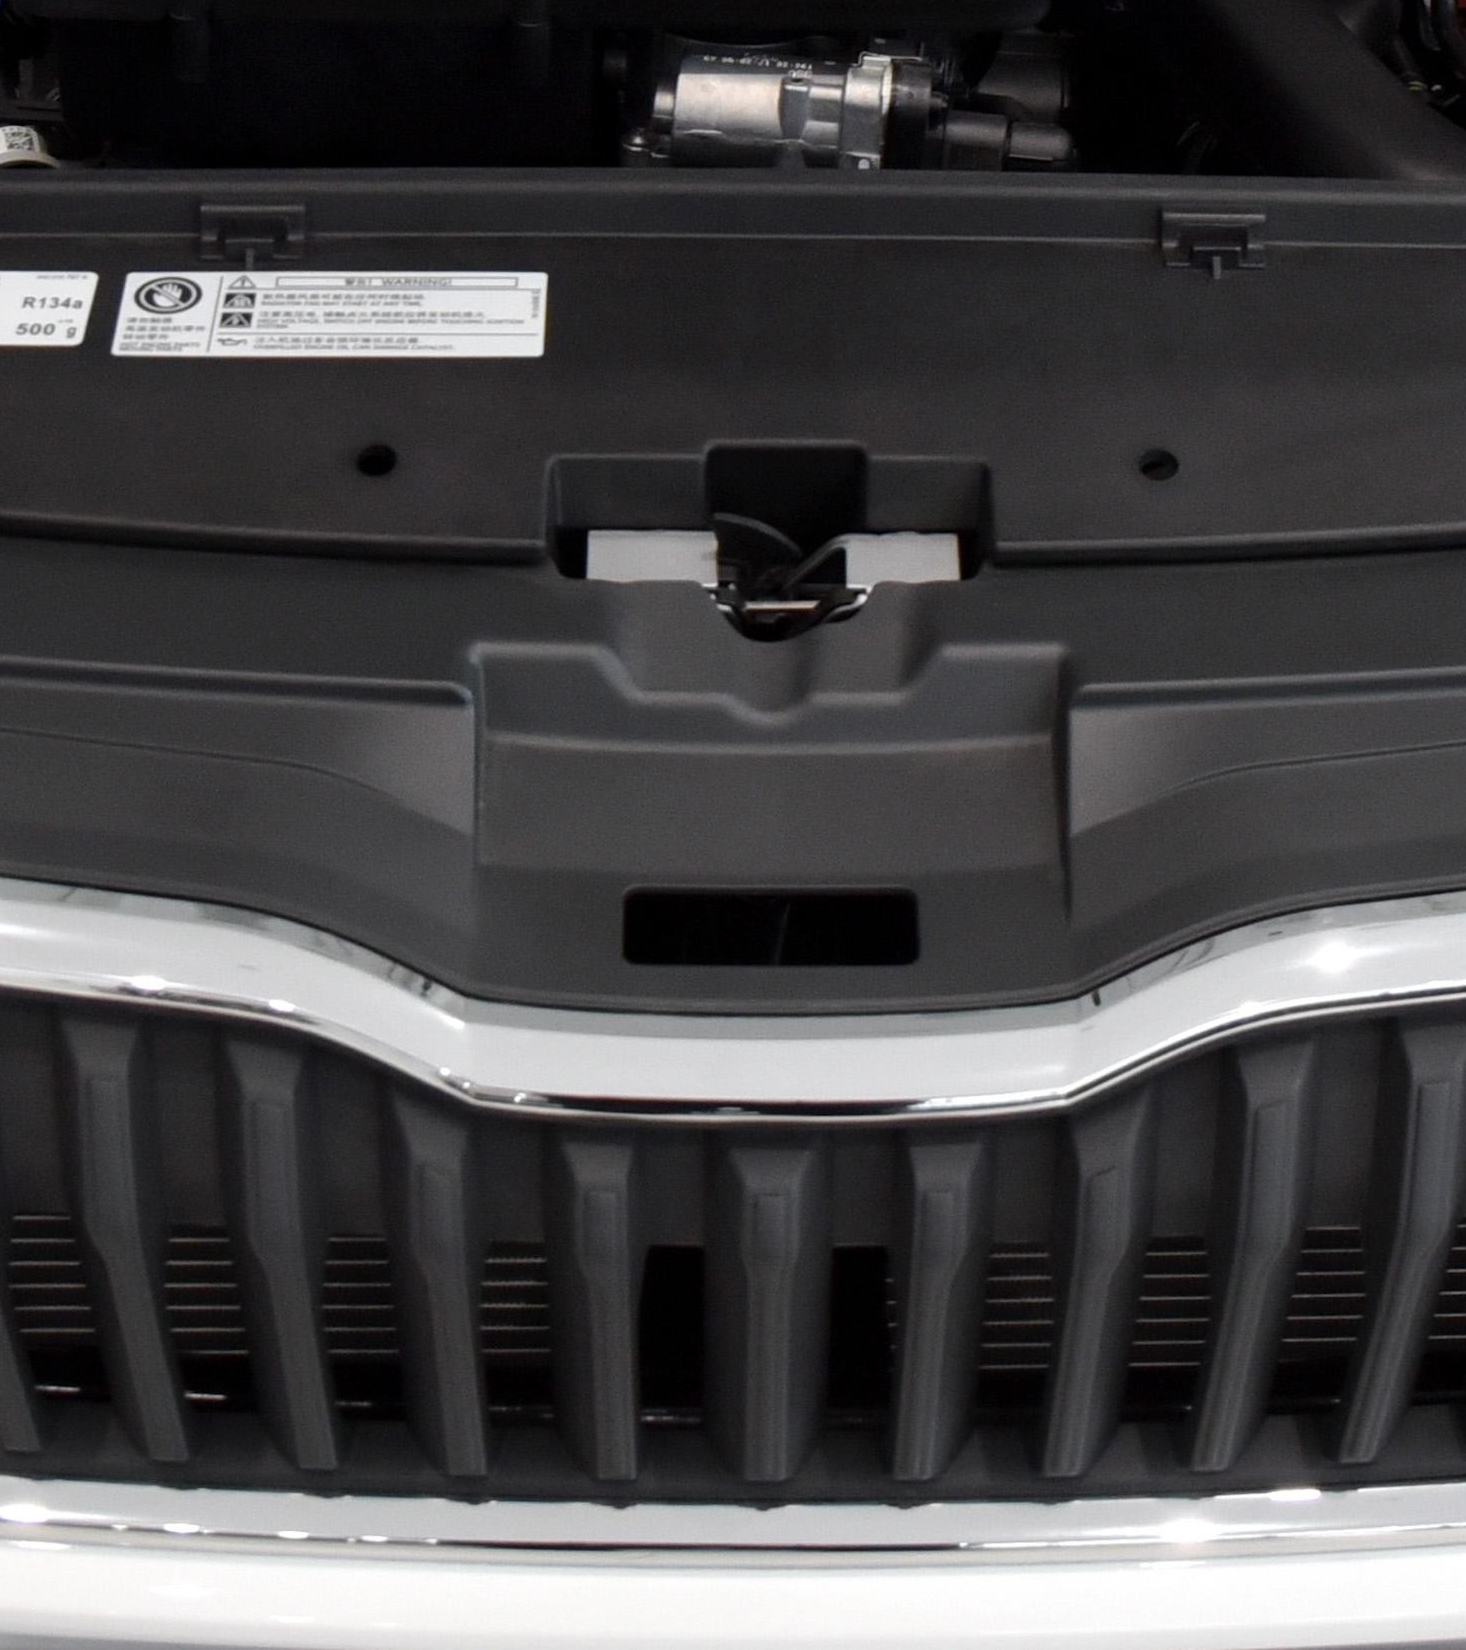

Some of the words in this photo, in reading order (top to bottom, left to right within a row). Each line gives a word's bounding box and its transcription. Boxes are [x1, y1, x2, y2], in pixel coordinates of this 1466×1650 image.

[22, 296, 83, 309] R134a
[16, 323, 55, 336] 500
[66, 326, 77, 338] g
